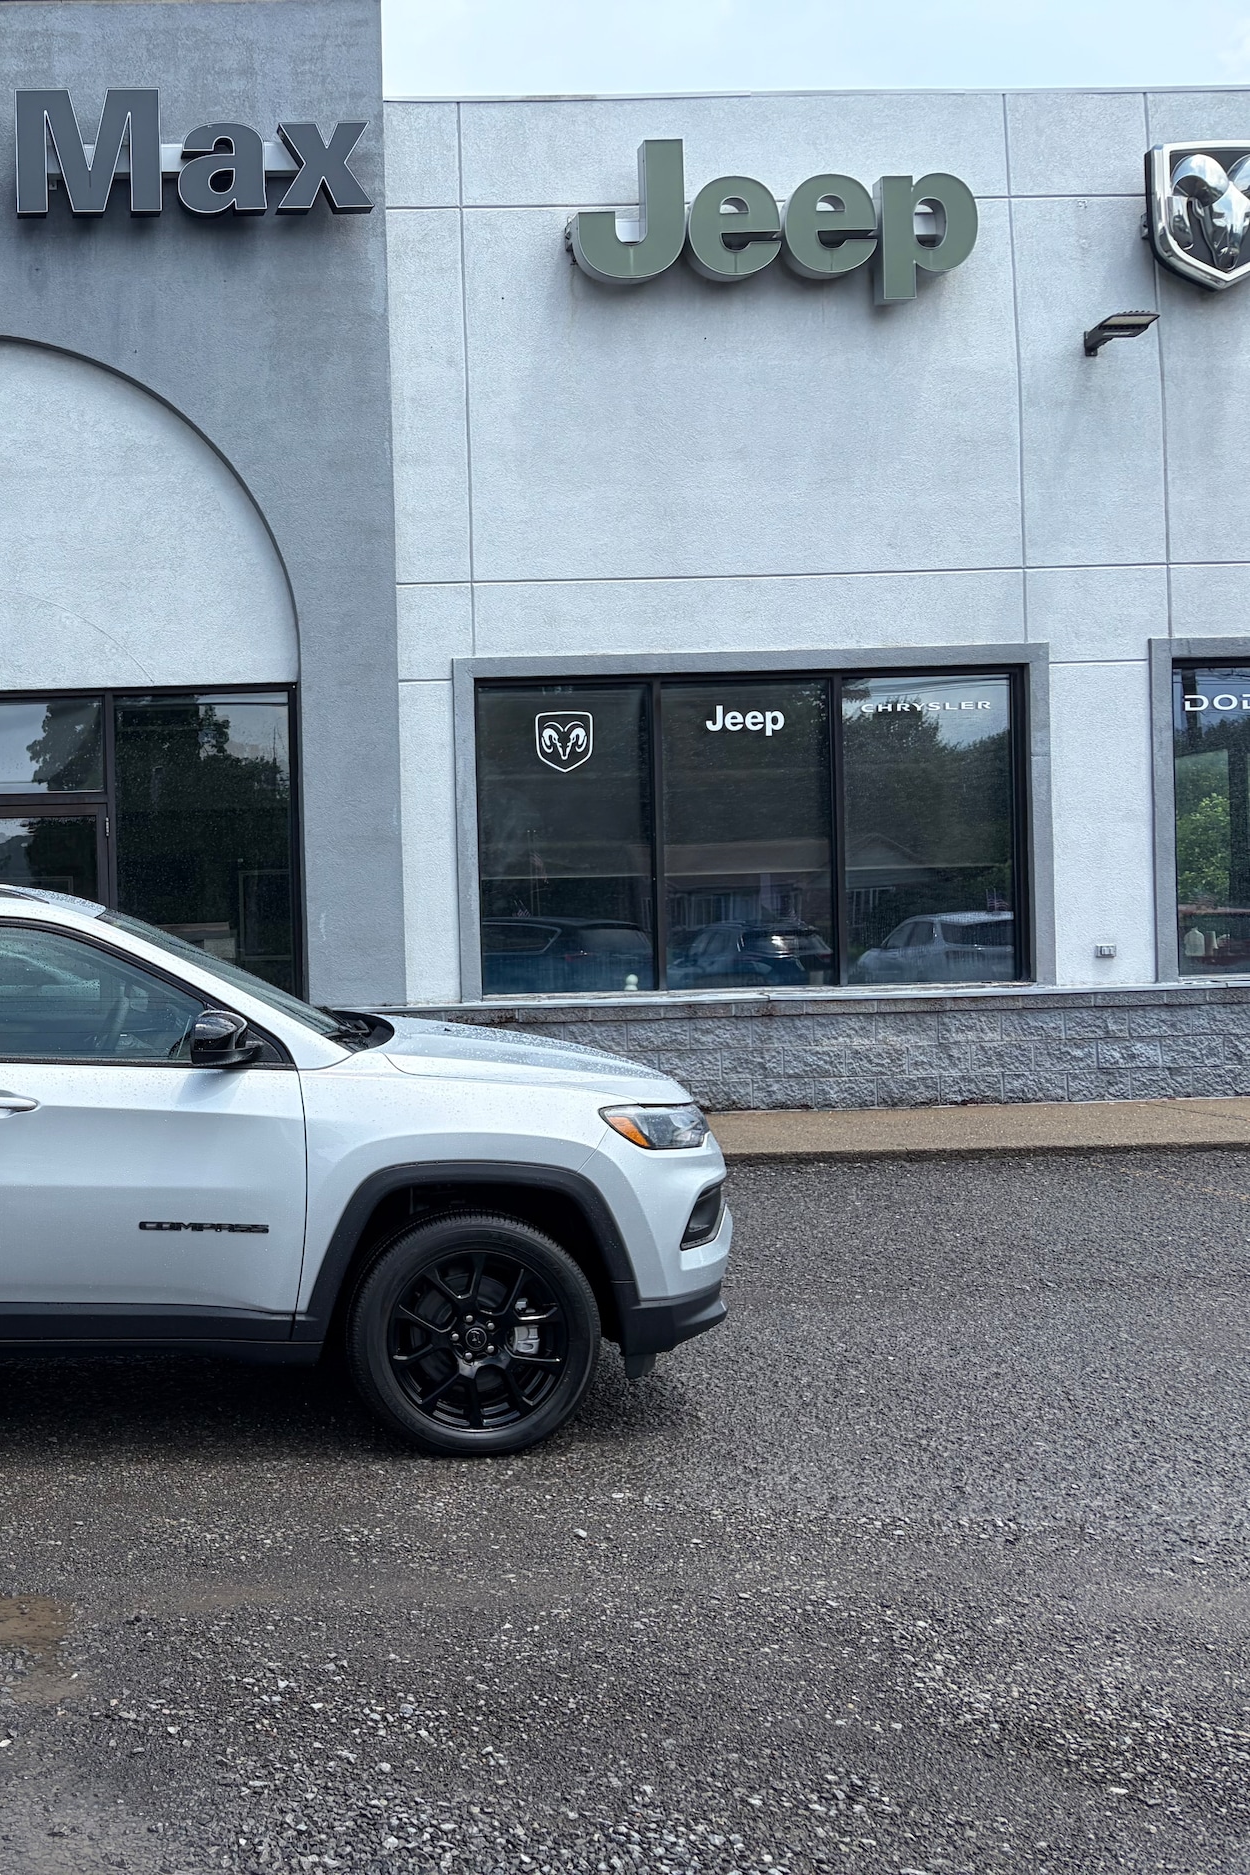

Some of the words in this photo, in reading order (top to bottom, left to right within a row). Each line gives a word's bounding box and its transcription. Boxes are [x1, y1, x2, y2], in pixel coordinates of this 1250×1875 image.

[14, 86, 376, 217] Max
[570, 138, 978, 305] Jeep
[705, 705, 786, 736] Jeep
[860, 700, 992, 713] CHRYSLER
[138, 1221, 270, 1234] COMPASS
